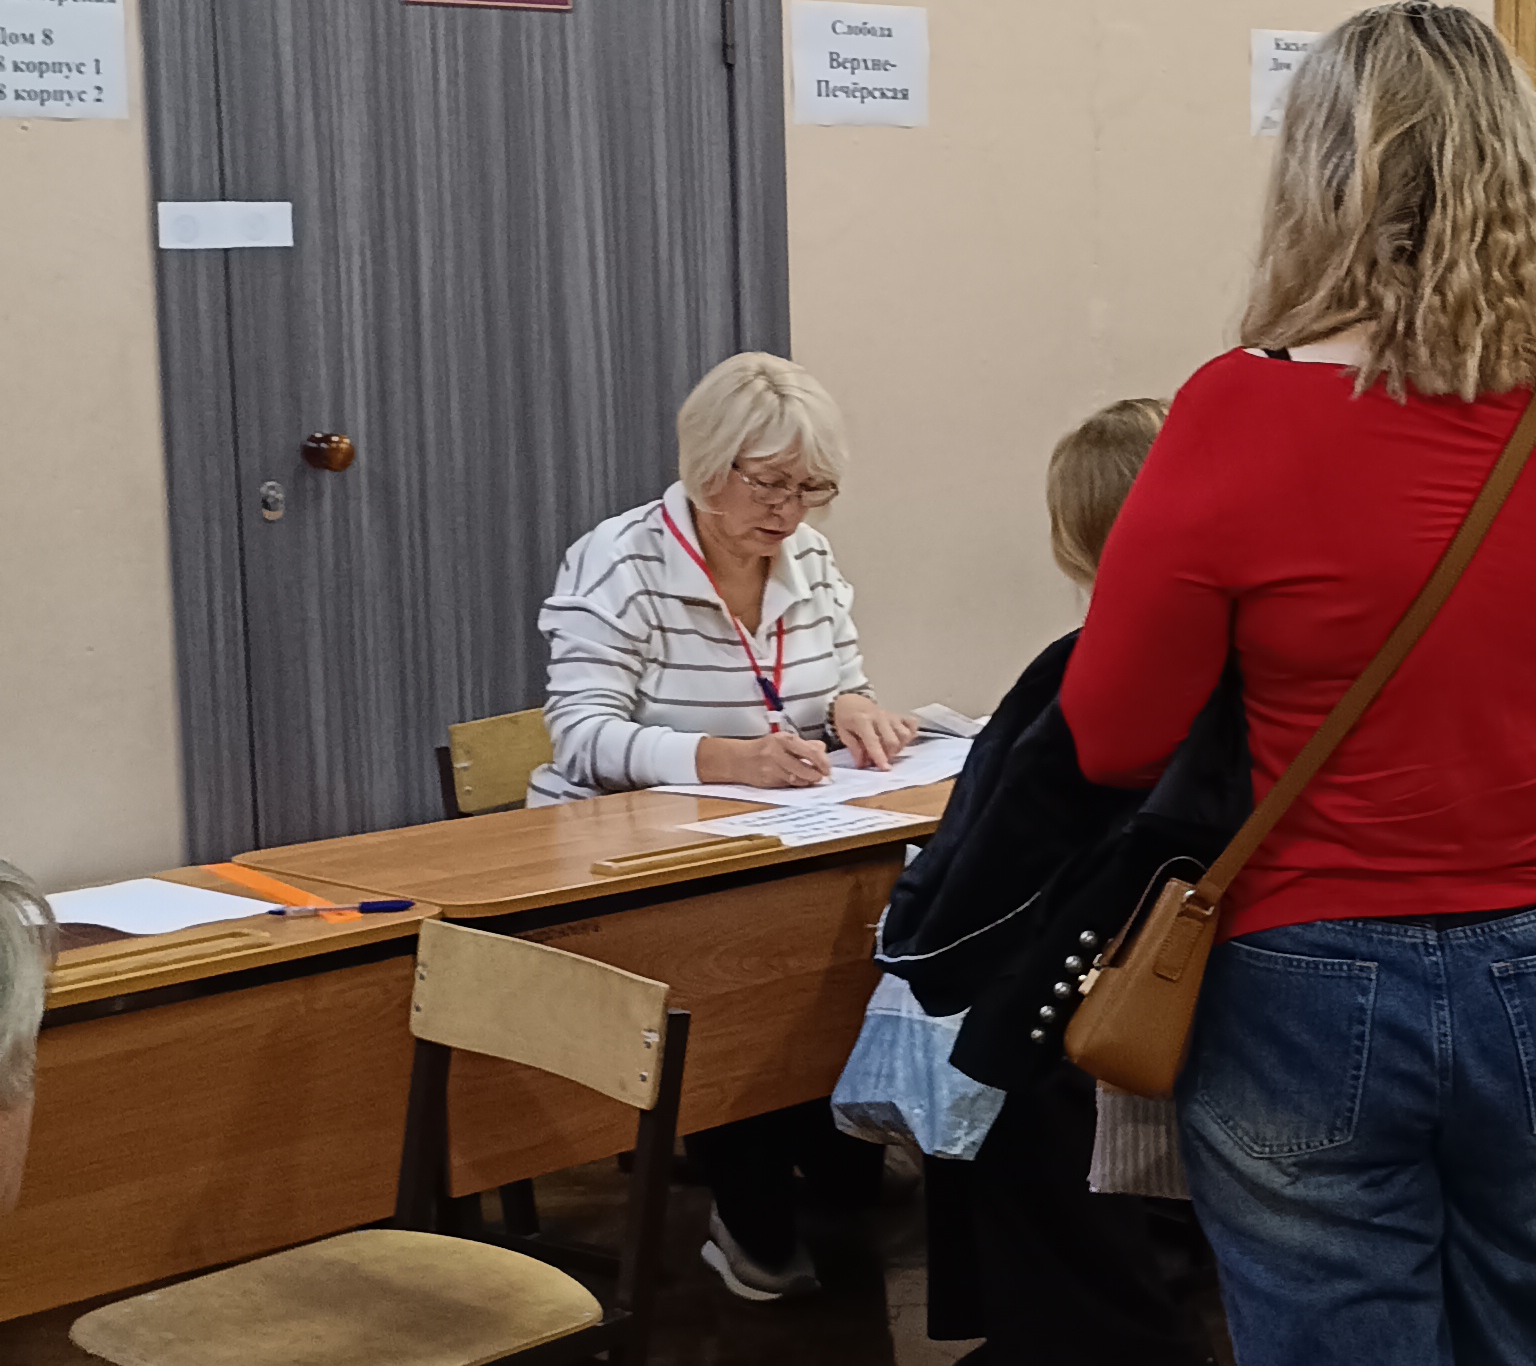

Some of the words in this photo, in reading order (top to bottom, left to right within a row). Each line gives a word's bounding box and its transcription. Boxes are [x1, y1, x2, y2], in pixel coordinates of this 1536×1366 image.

[41, 28, 54, 46] 8
[831, 19, 893, 38] Слобода
[12, 60, 86, 79] корпус
[93, 58, 103, 75] 1
[828, 51, 897, 75] Верхне-
[14, 88, 88, 107] корпус
[93, 85, 104, 103] 2
[816, 79, 909, 104] Печёрская
